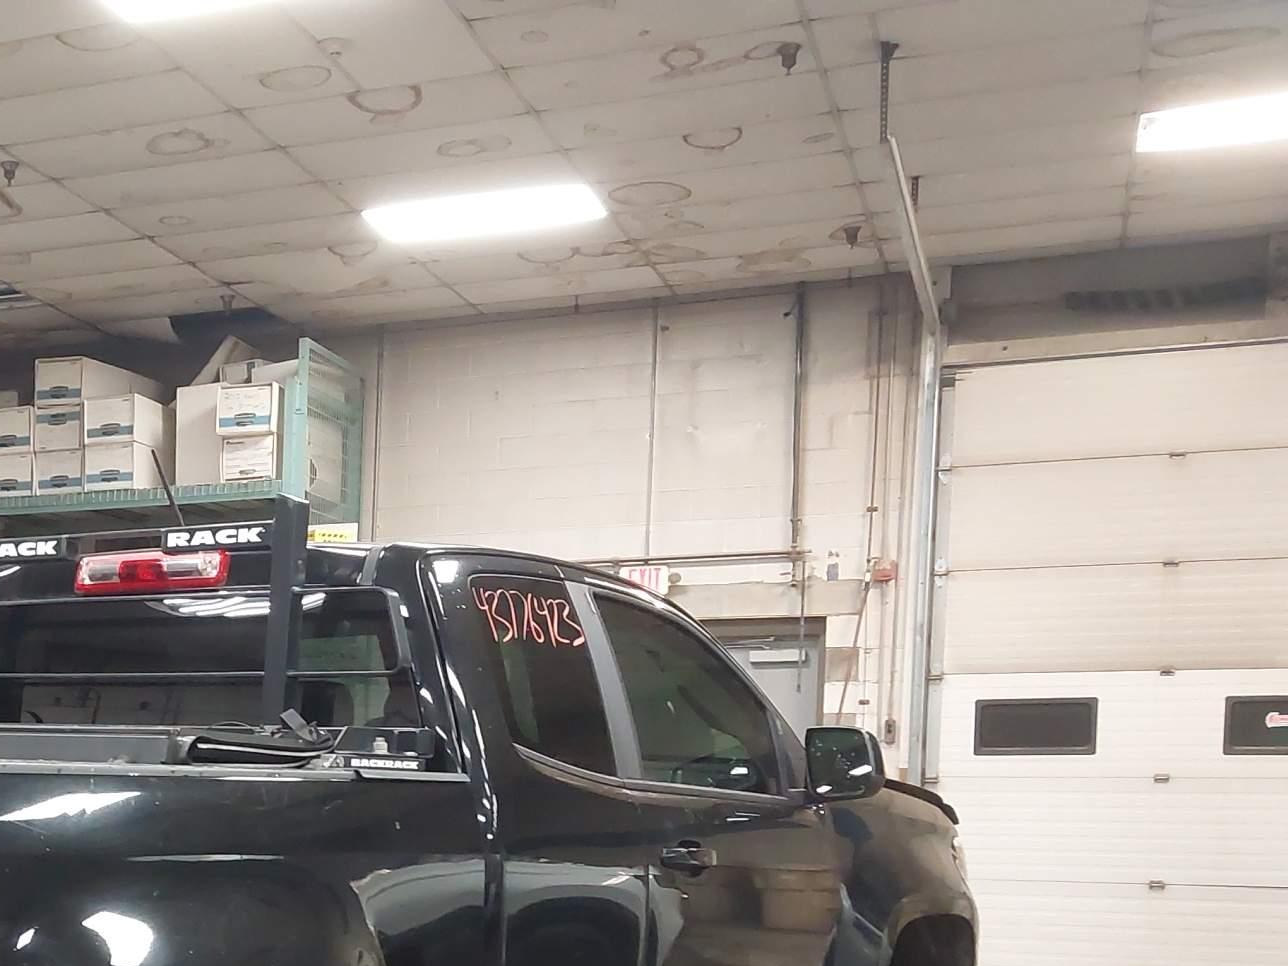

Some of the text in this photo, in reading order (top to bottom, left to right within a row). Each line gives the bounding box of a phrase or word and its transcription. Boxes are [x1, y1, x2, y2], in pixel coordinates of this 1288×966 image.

[166, 527, 263, 549] RACK
[471, 587, 585, 648] 43776423
[350, 758, 420, 770] BACKRACK
